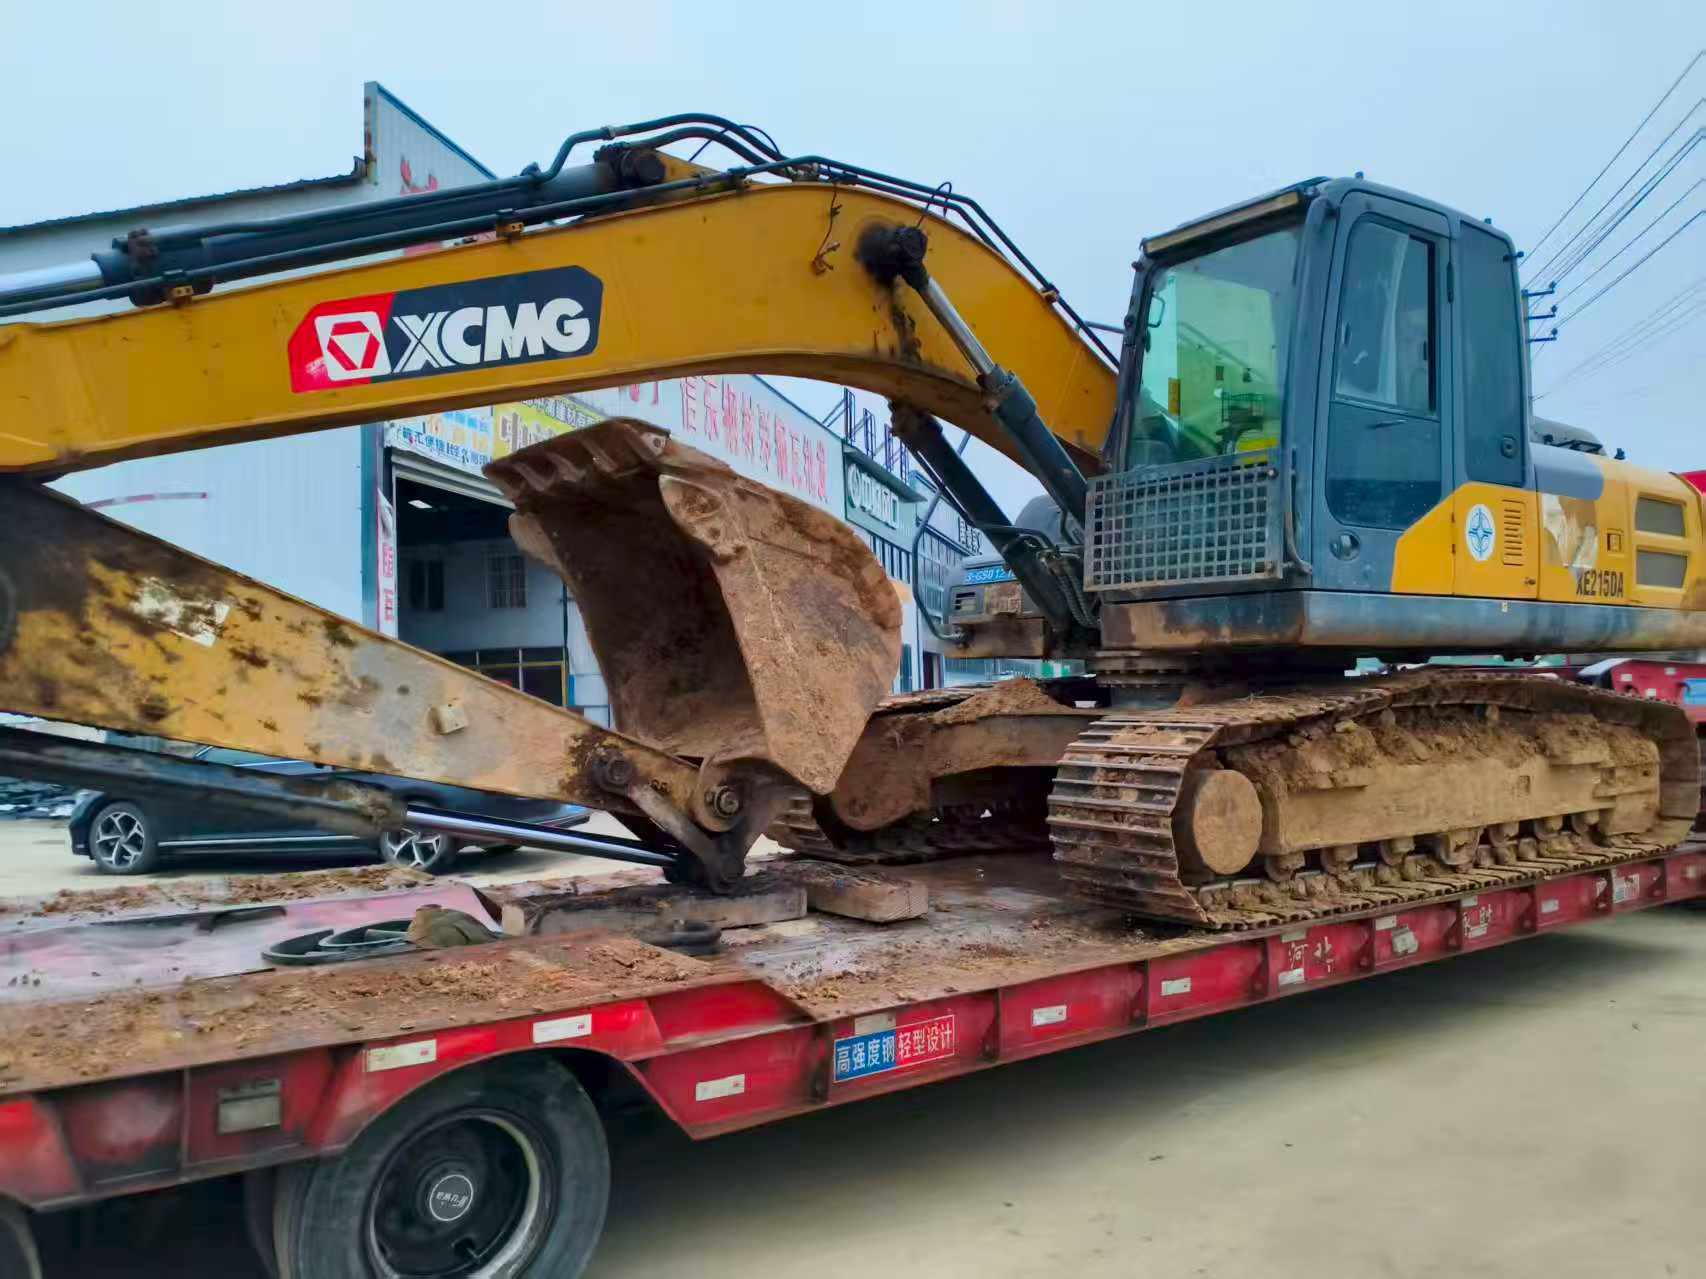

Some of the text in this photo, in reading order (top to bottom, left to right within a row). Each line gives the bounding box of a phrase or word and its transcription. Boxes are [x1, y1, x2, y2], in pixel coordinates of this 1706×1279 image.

[392, 298, 591, 373] XCMG
[836, 1022, 953, 1074] 高强度钢 轻型设计
